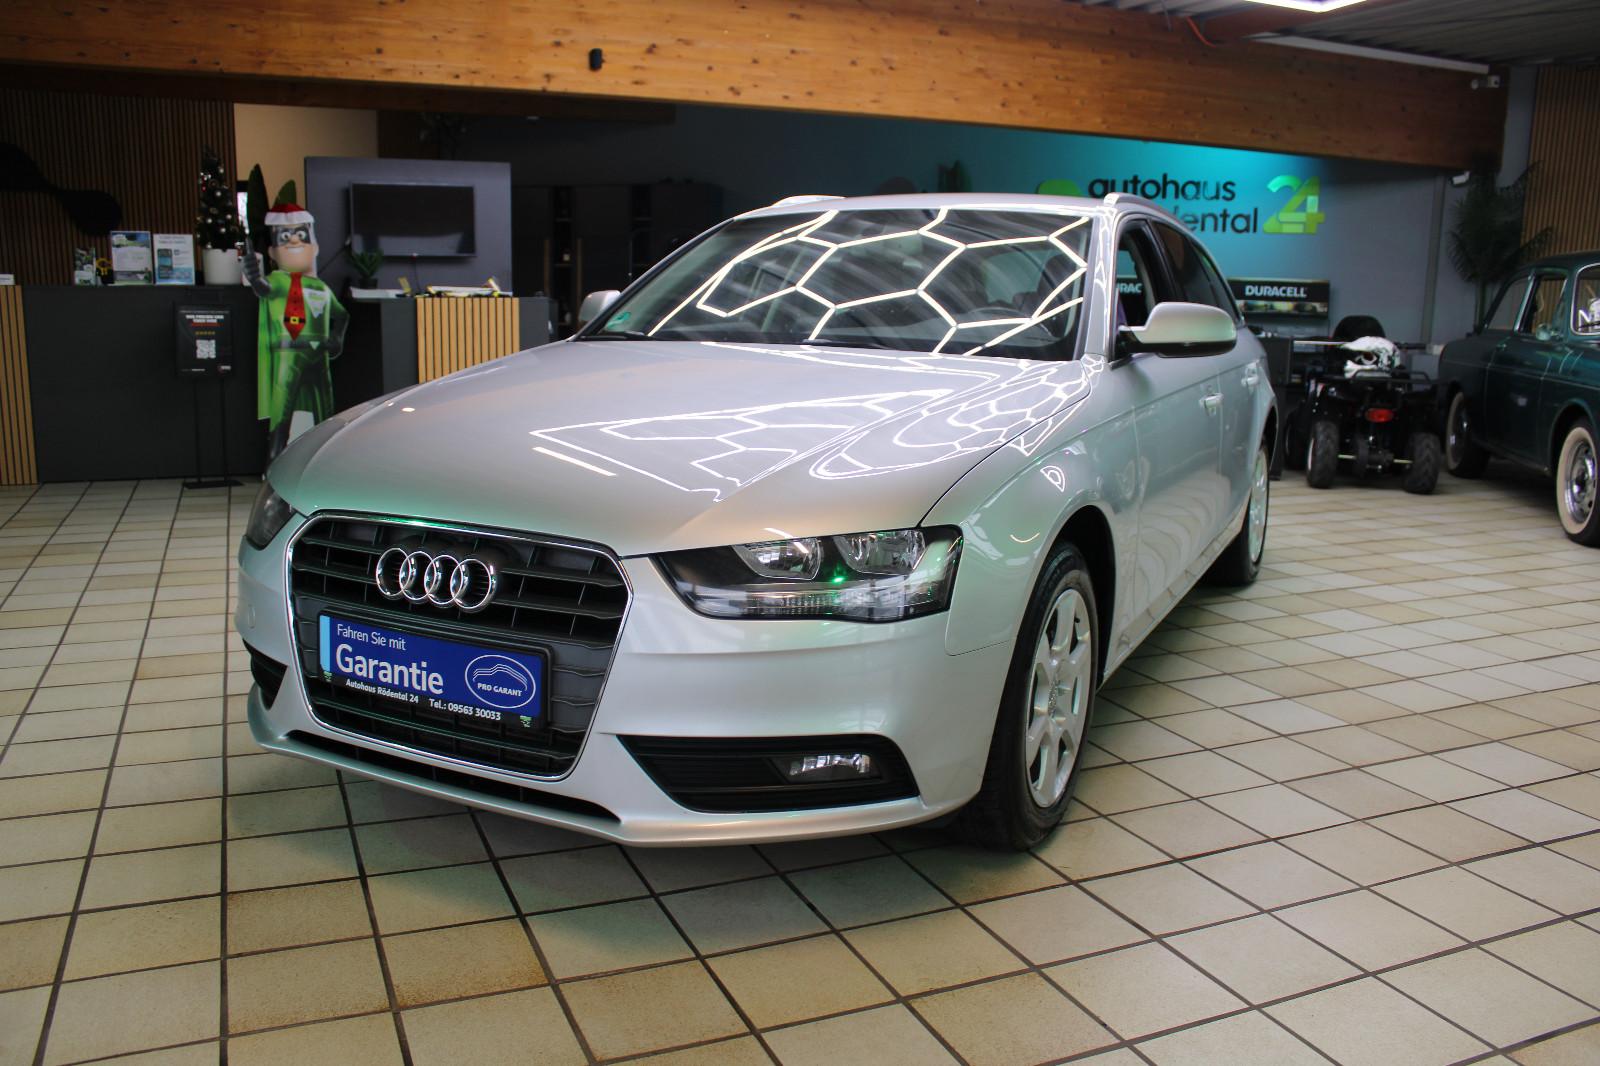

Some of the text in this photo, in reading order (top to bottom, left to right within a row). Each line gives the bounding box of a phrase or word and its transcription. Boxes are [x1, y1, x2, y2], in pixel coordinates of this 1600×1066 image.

[1088, 173, 1236, 201] autohaus
[1263, 174, 1326, 235] 24
[1245, 284, 1307, 298] DURACELL
[336, 623, 407, 651] Fahren Sie mit
[336, 643, 444, 695] Garantie
[345, 678, 502, 721] Autohaus Rödental 24 Tel.: 09563 30033
[477, 682, 522, 697] PRO GARANT
